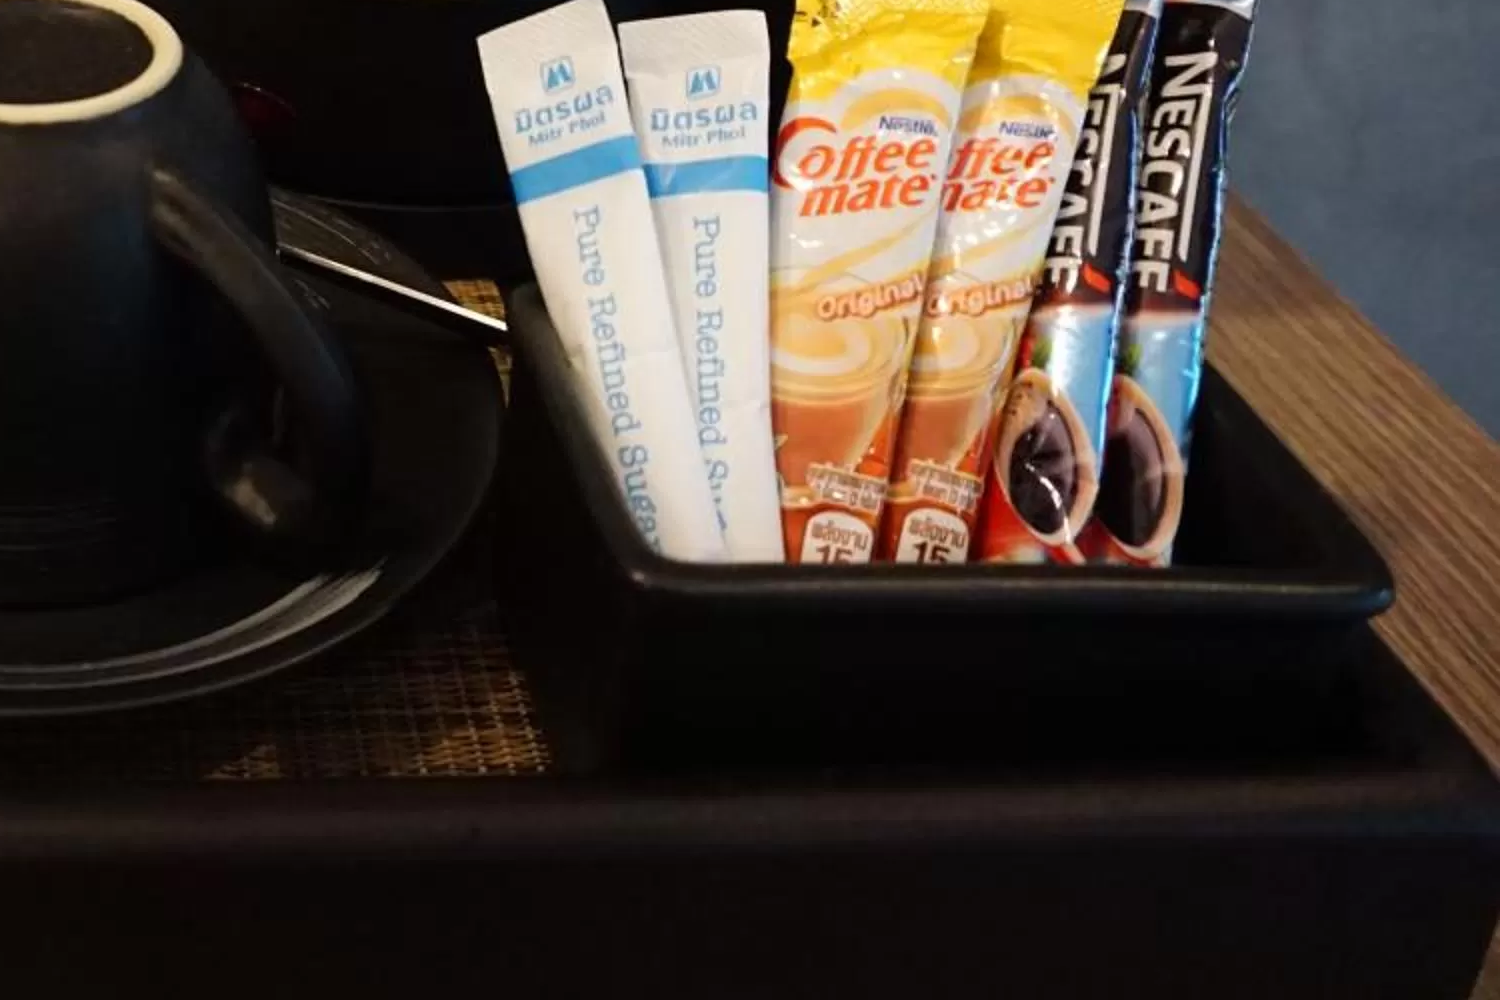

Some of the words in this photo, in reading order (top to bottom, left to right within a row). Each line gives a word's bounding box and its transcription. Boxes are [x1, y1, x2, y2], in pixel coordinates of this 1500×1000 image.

[527, 127, 565, 148] Mitr
[569, 110, 607, 134] Phol
[661, 133, 699, 149] Mitr
[707, 126, 746, 146] Phol
[772, 116, 939, 190] Coffee
[948, 136, 1056, 180] ffee
[799, 174, 931, 217] mate
[573, 205, 605, 286] Pure
[692, 215, 721, 297] Pure
[816, 273, 924, 320] Original
[926, 275, 1034, 319] Original
[587, 292, 642, 437] Refined
[695, 307, 728, 447] Refined
